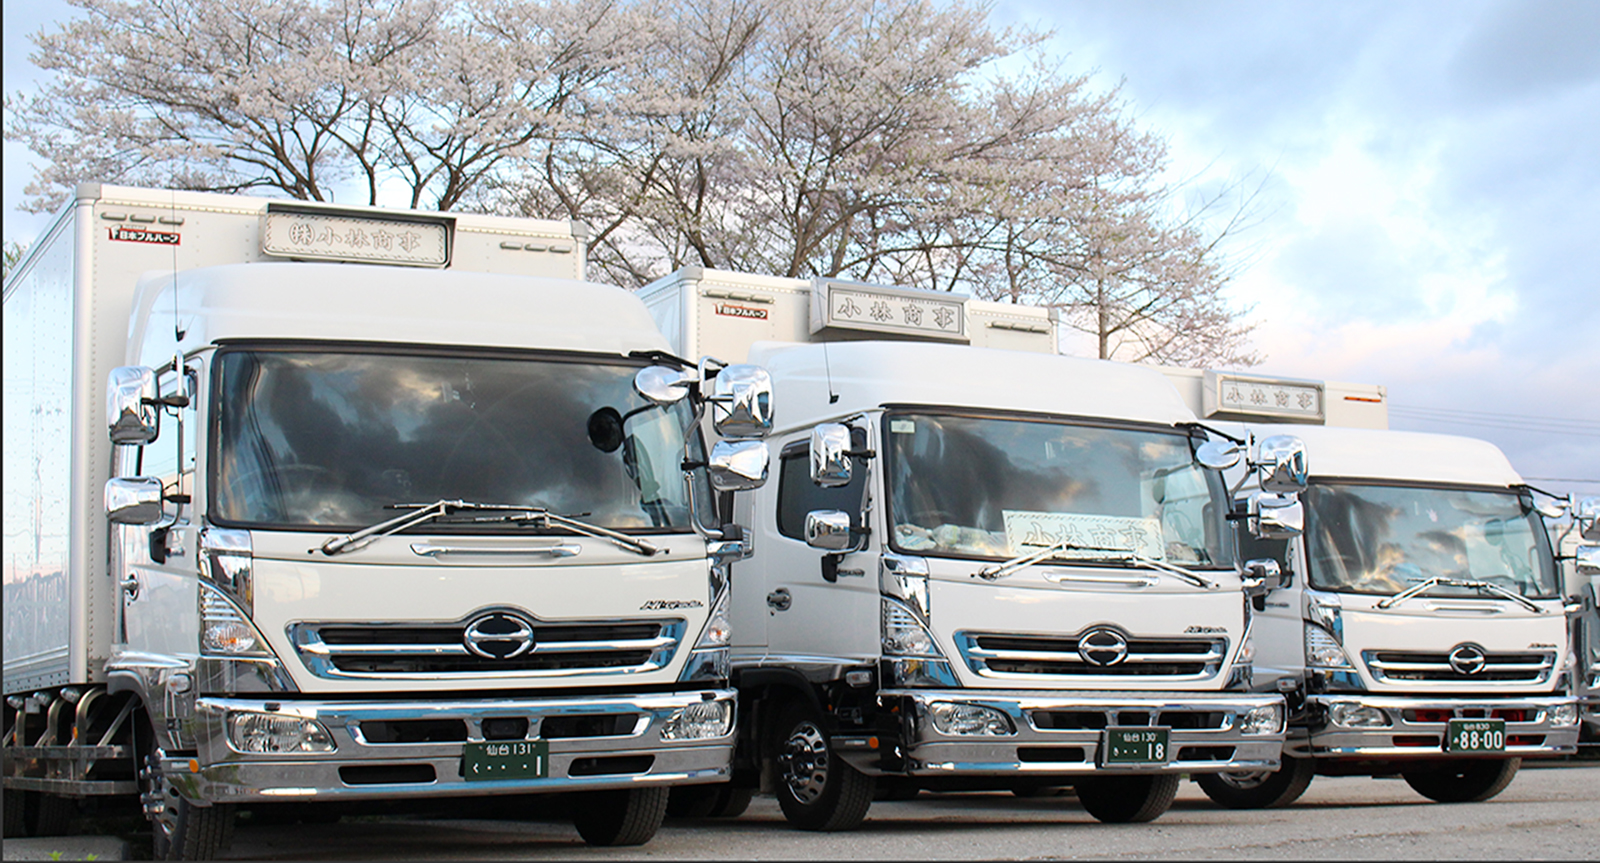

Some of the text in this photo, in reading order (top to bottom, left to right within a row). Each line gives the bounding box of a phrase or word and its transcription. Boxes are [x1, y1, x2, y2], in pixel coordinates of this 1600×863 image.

[837, 297, 955, 329] 小林商事
[513, 742, 532, 756] 131
